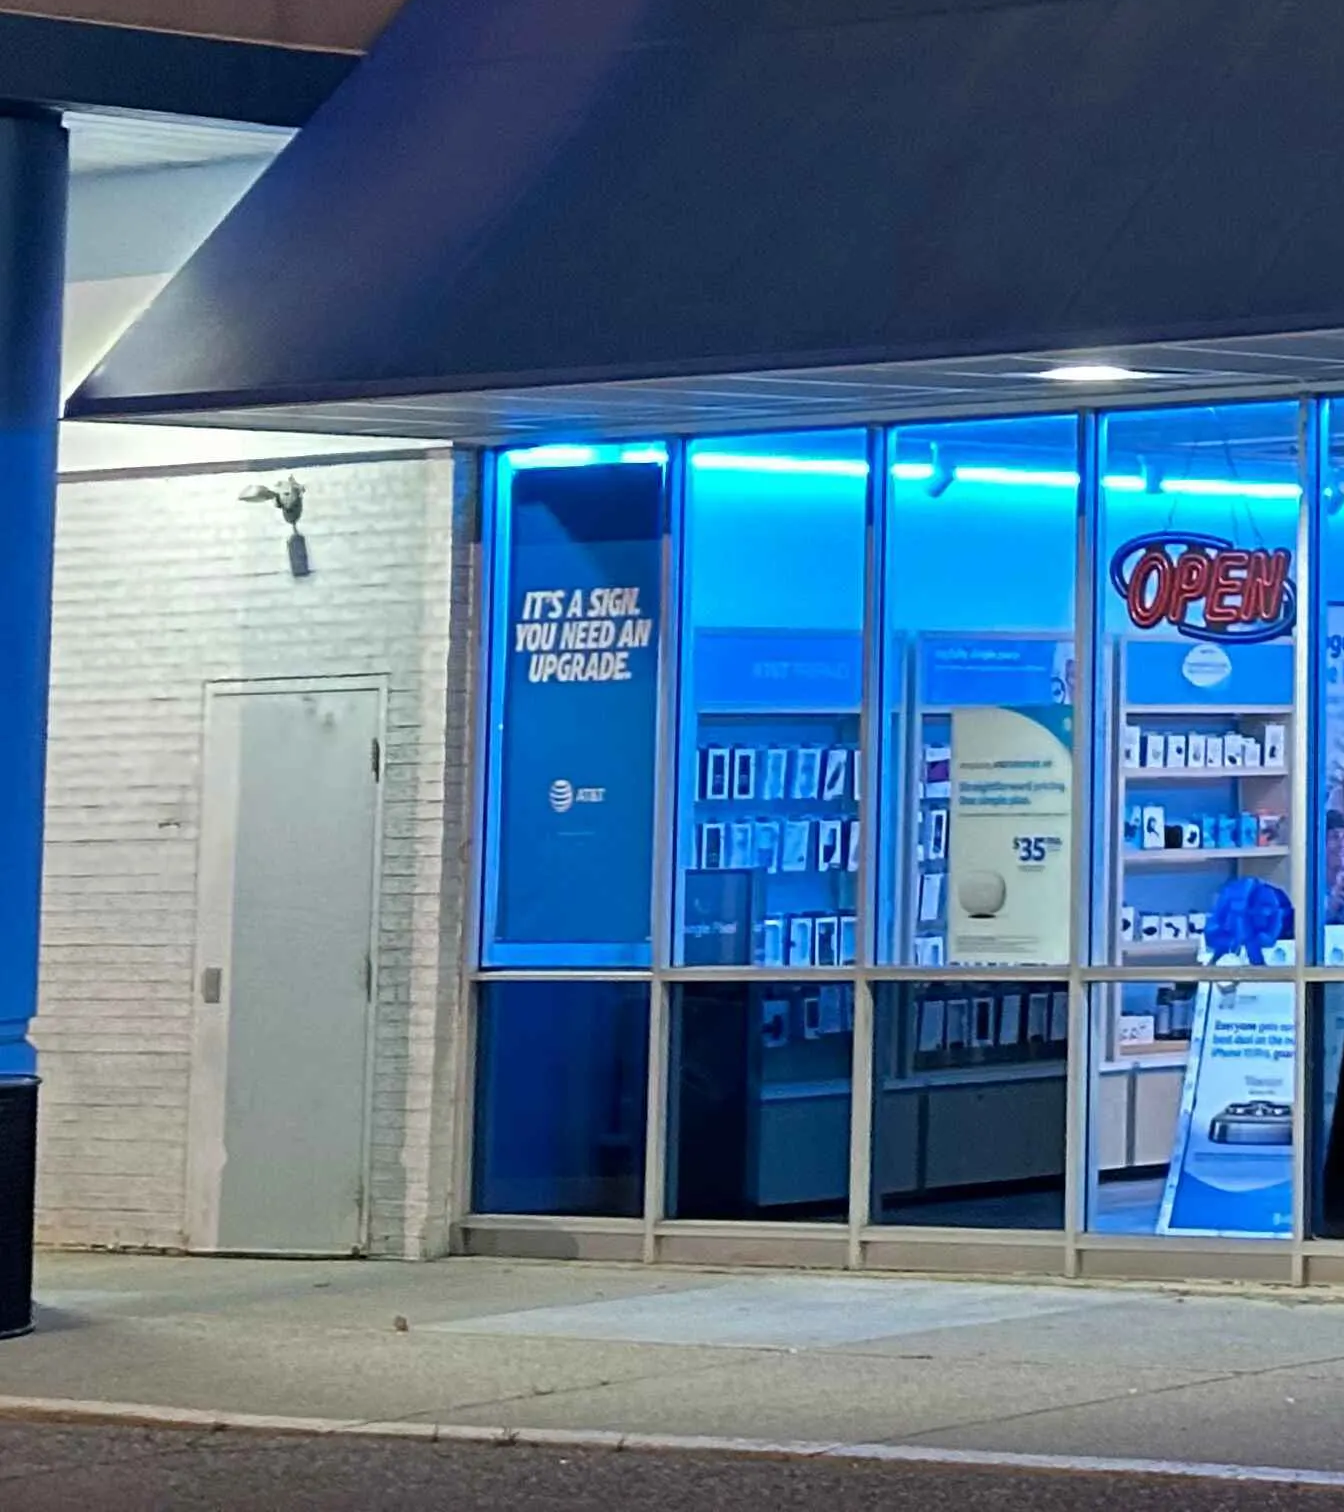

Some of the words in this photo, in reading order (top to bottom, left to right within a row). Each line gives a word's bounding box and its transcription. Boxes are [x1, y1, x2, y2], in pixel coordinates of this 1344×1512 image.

[523, 591, 565, 619] IT'S
[566, 589, 583, 618] A
[587, 588, 641, 618] SIGN.
[1128, 550, 1289, 628] OPEN
[515, 623, 557, 652] YOU
[559, 620, 615, 650] NEED
[617, 619, 652, 648] AN
[529, 652, 632, 683] UPGRADE.
